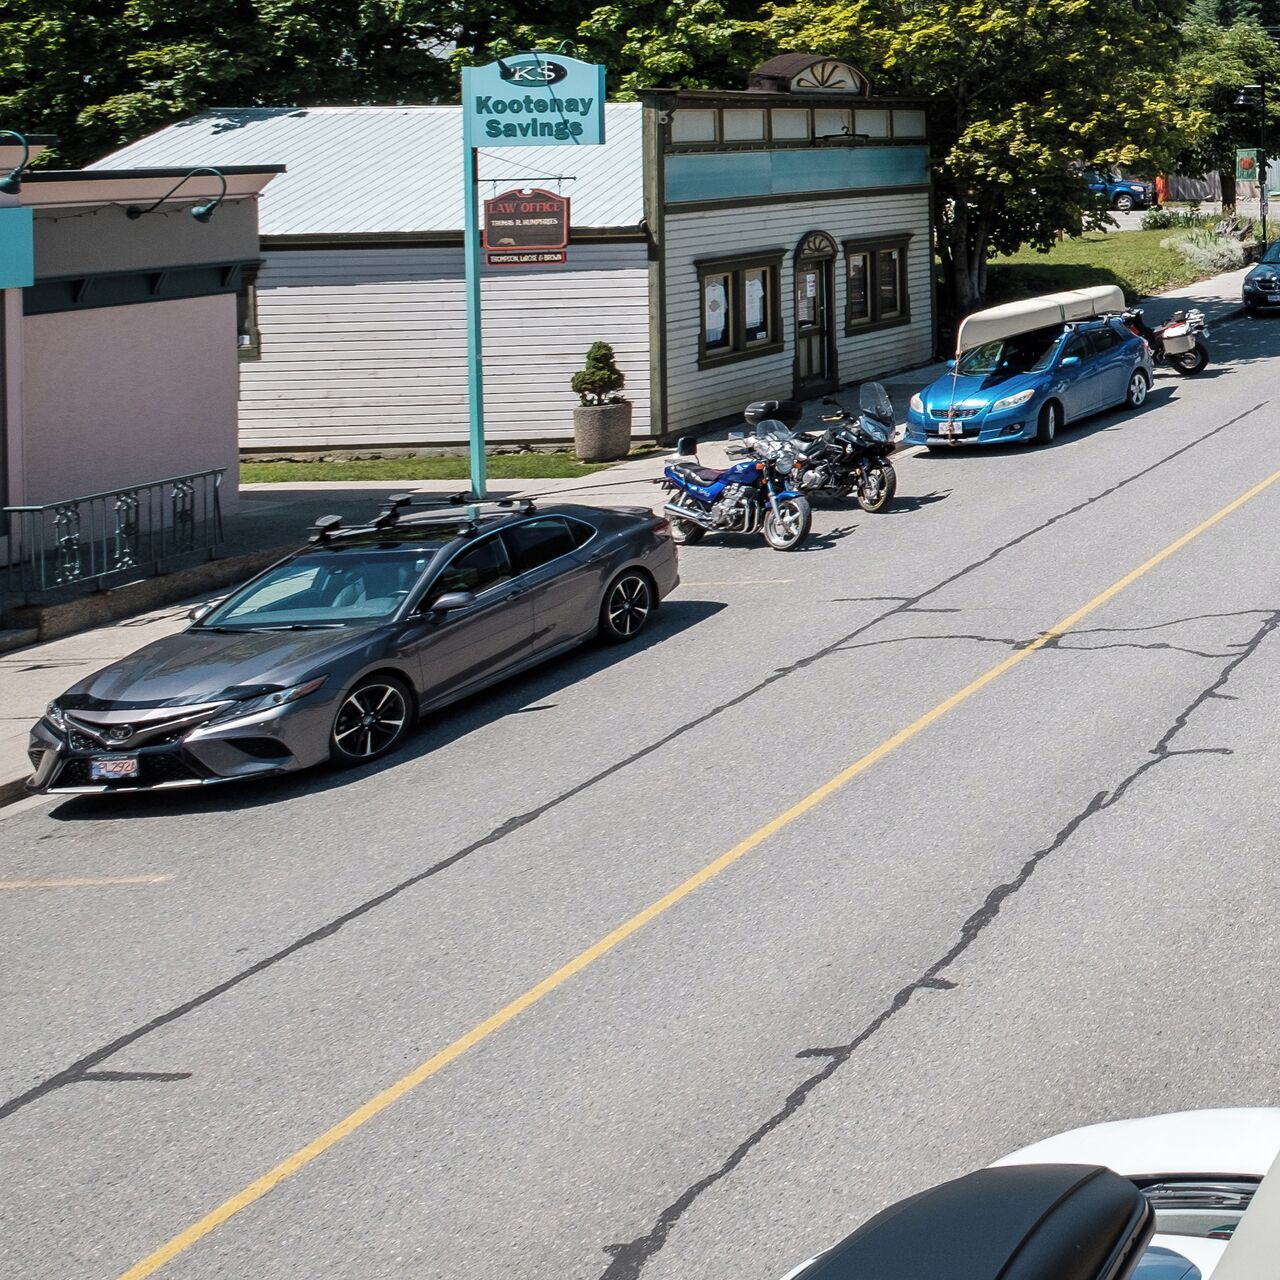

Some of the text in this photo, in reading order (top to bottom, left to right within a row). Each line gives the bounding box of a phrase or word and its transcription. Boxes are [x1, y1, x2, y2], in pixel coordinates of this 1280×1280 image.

[475, 95, 594, 116] Kootenay
[485, 118, 584, 140] Savings
[489, 202, 560, 213] LAW OFFICE
